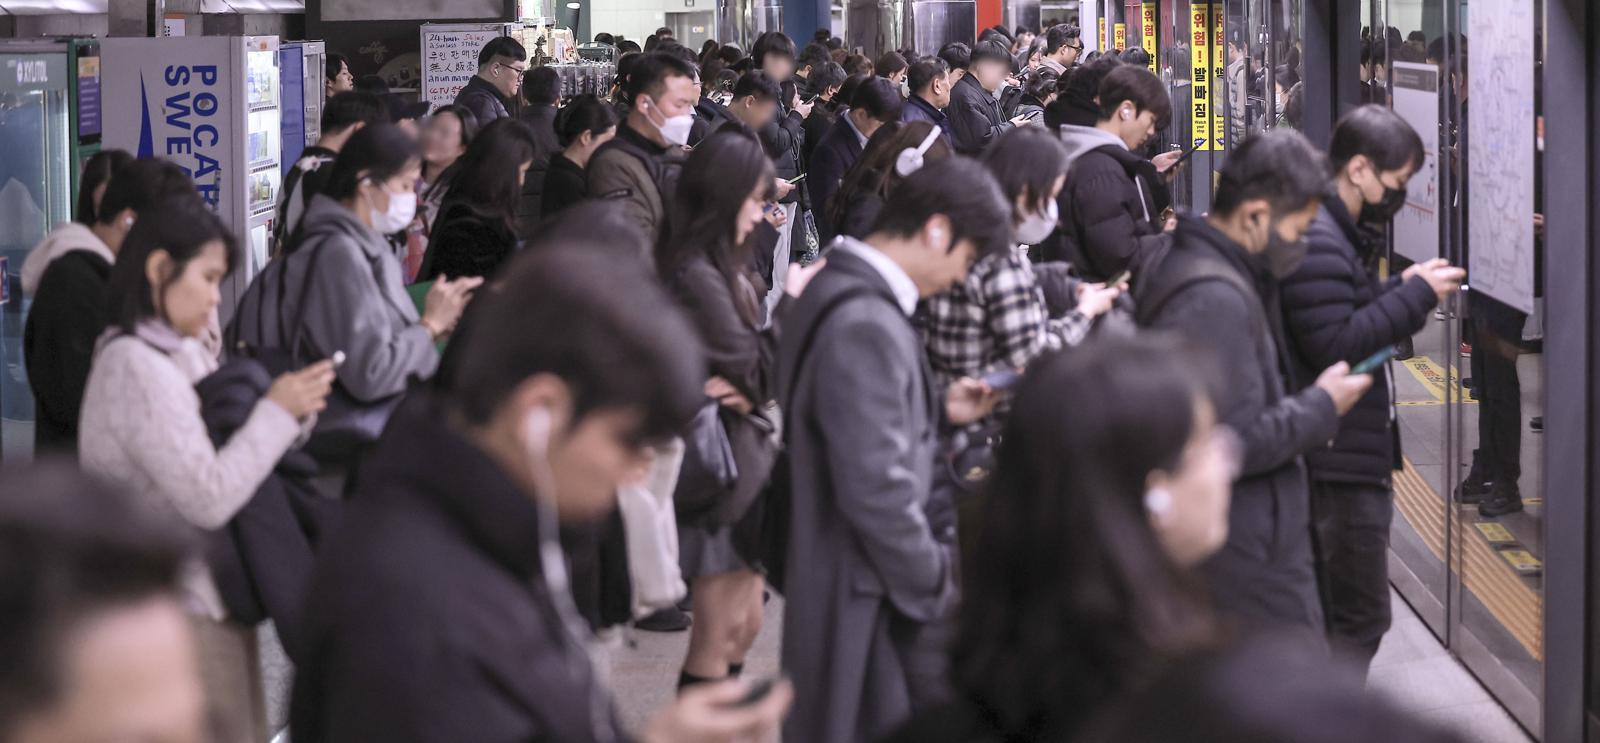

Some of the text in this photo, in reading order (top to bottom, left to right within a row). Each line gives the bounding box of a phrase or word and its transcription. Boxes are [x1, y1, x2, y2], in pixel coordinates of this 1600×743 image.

[1144, 10, 1153, 50] 위험!
[23, 60, 48, 82] XYLITOL
[429, 50, 479, 61] 무인 판매점
[429, 61, 478, 73] 無人販売
[1194, 13, 1207, 118] 위험! 발빠짐
[429, 86, 450, 94] CCTV
[164, 65, 192, 177] SWE
[192, 65, 219, 207] POCAR
